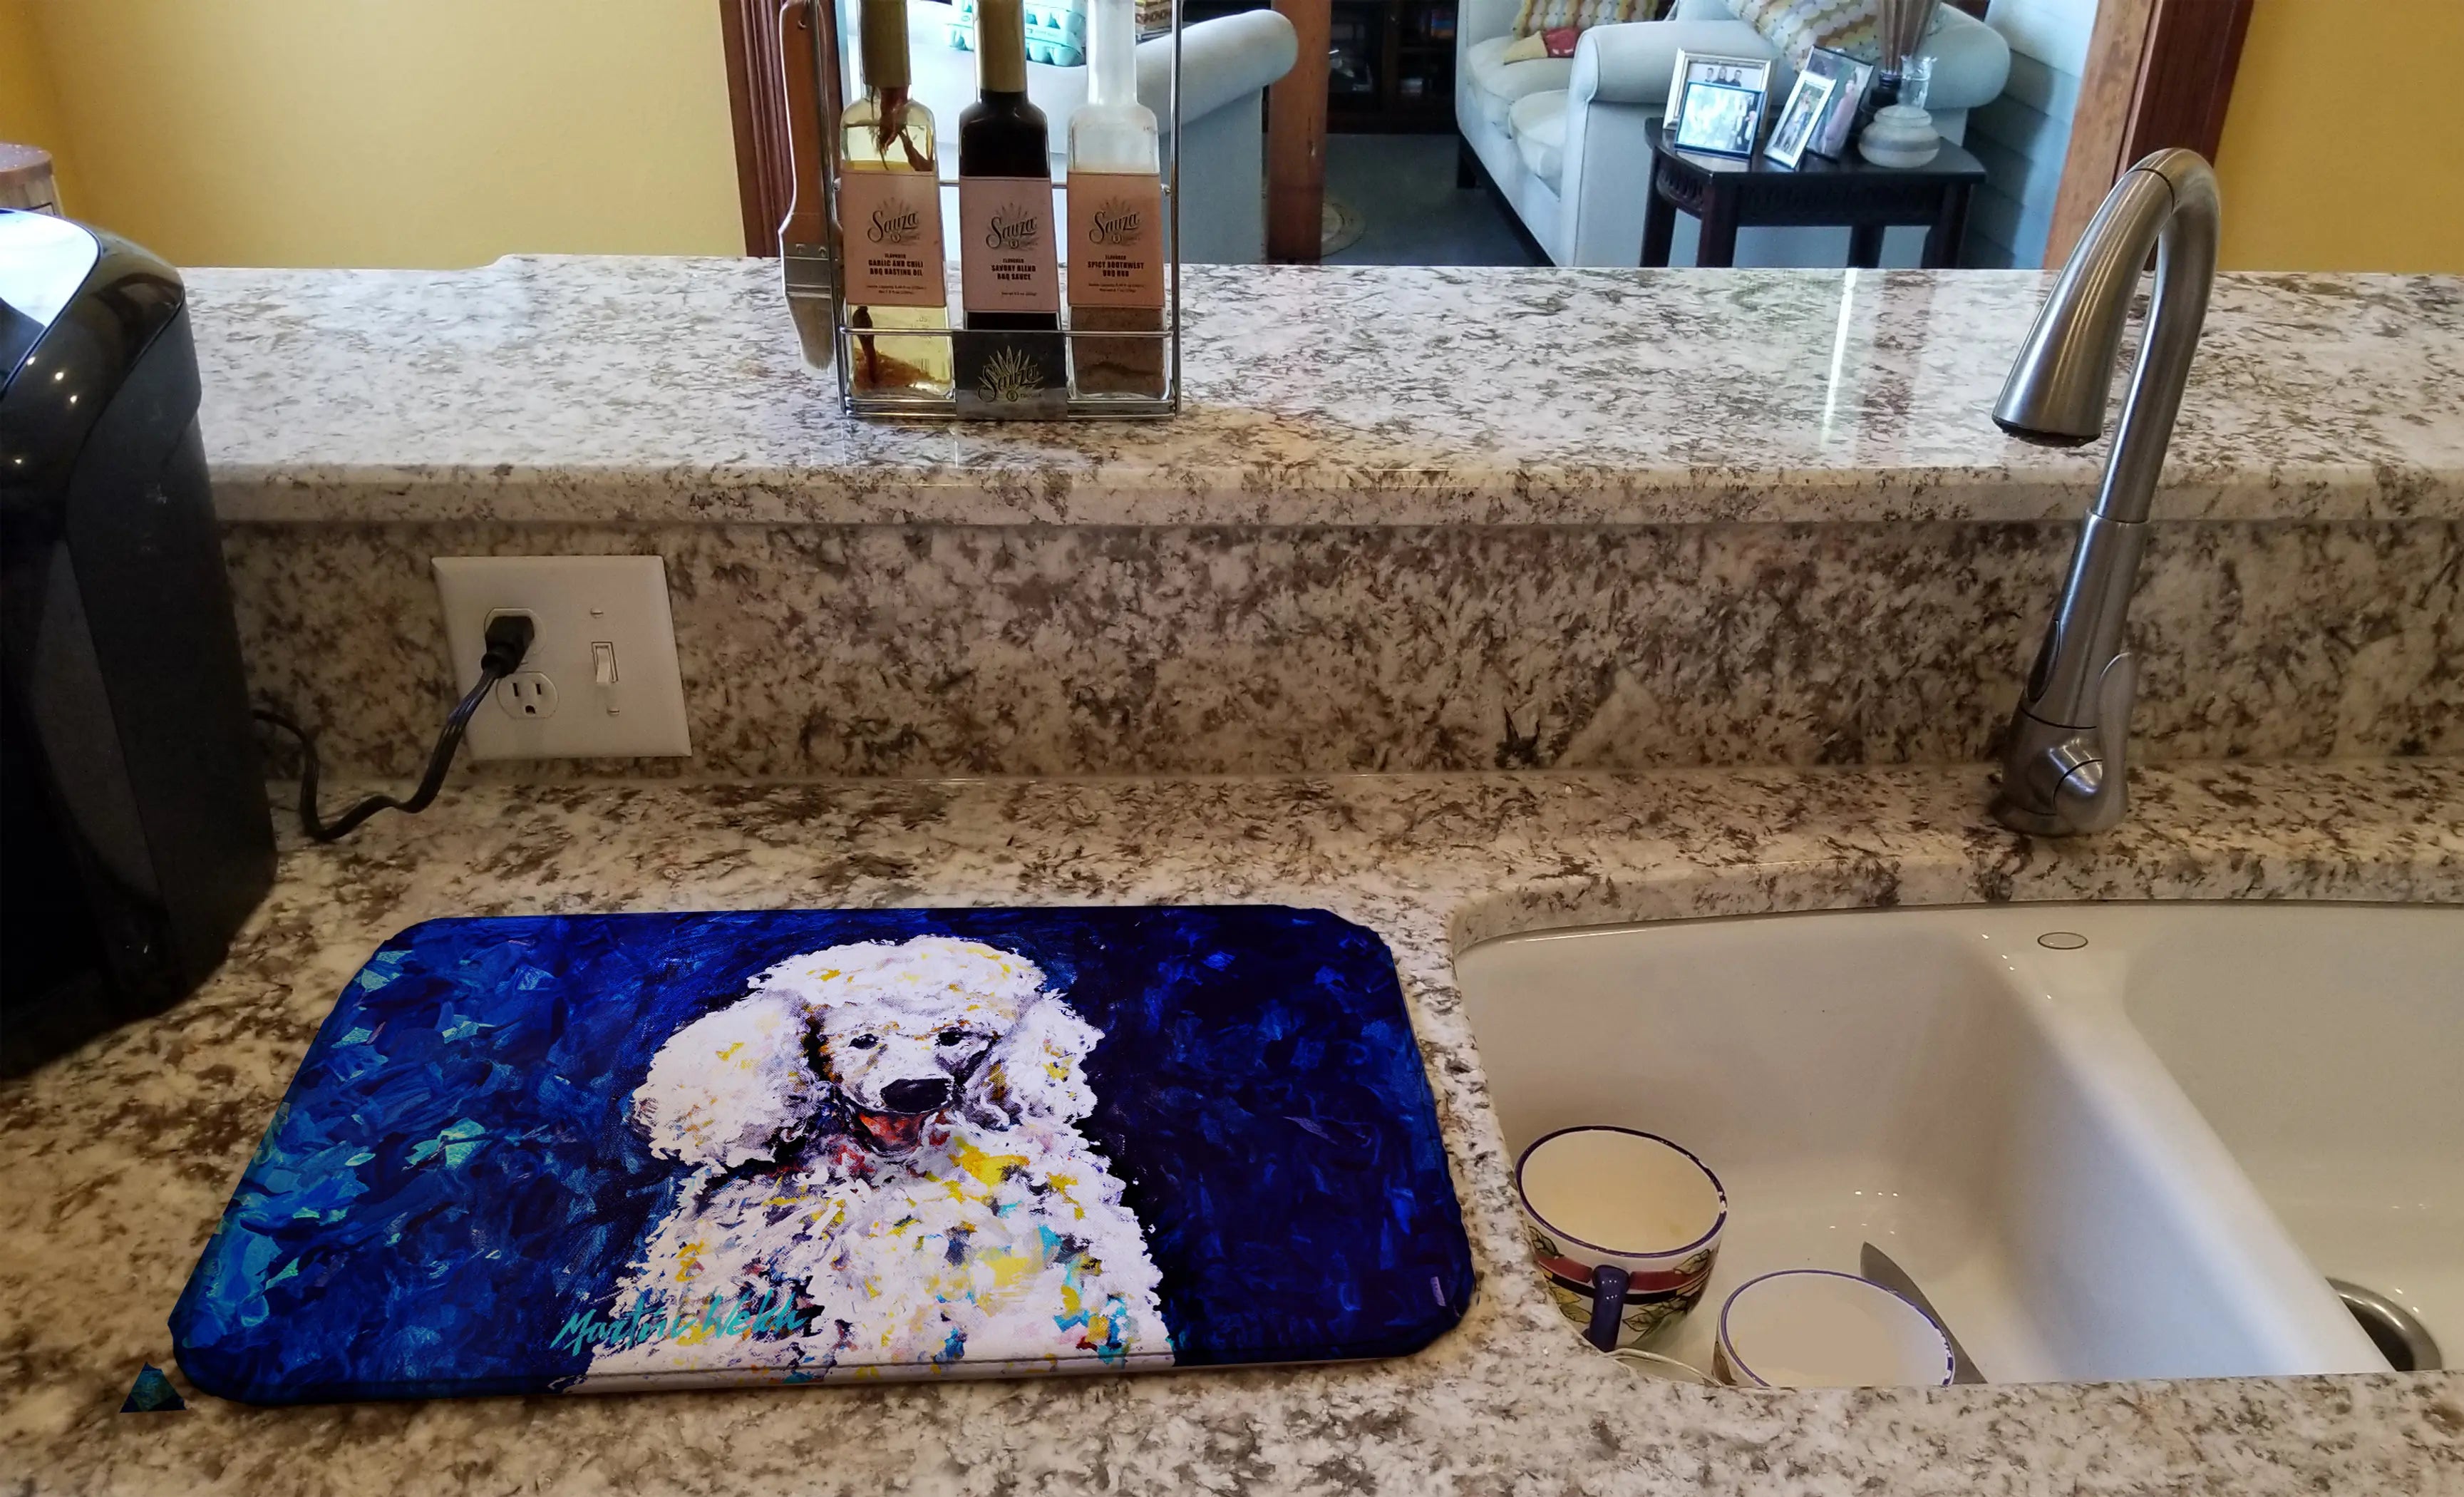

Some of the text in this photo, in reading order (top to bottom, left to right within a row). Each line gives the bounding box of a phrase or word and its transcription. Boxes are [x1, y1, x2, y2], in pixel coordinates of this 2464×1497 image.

[867, 210, 919, 243] Sauza
[986, 216, 1037, 249] Sauza
[1089, 211, 1140, 245] Sauza
[978, 364, 1038, 403] Sauza
